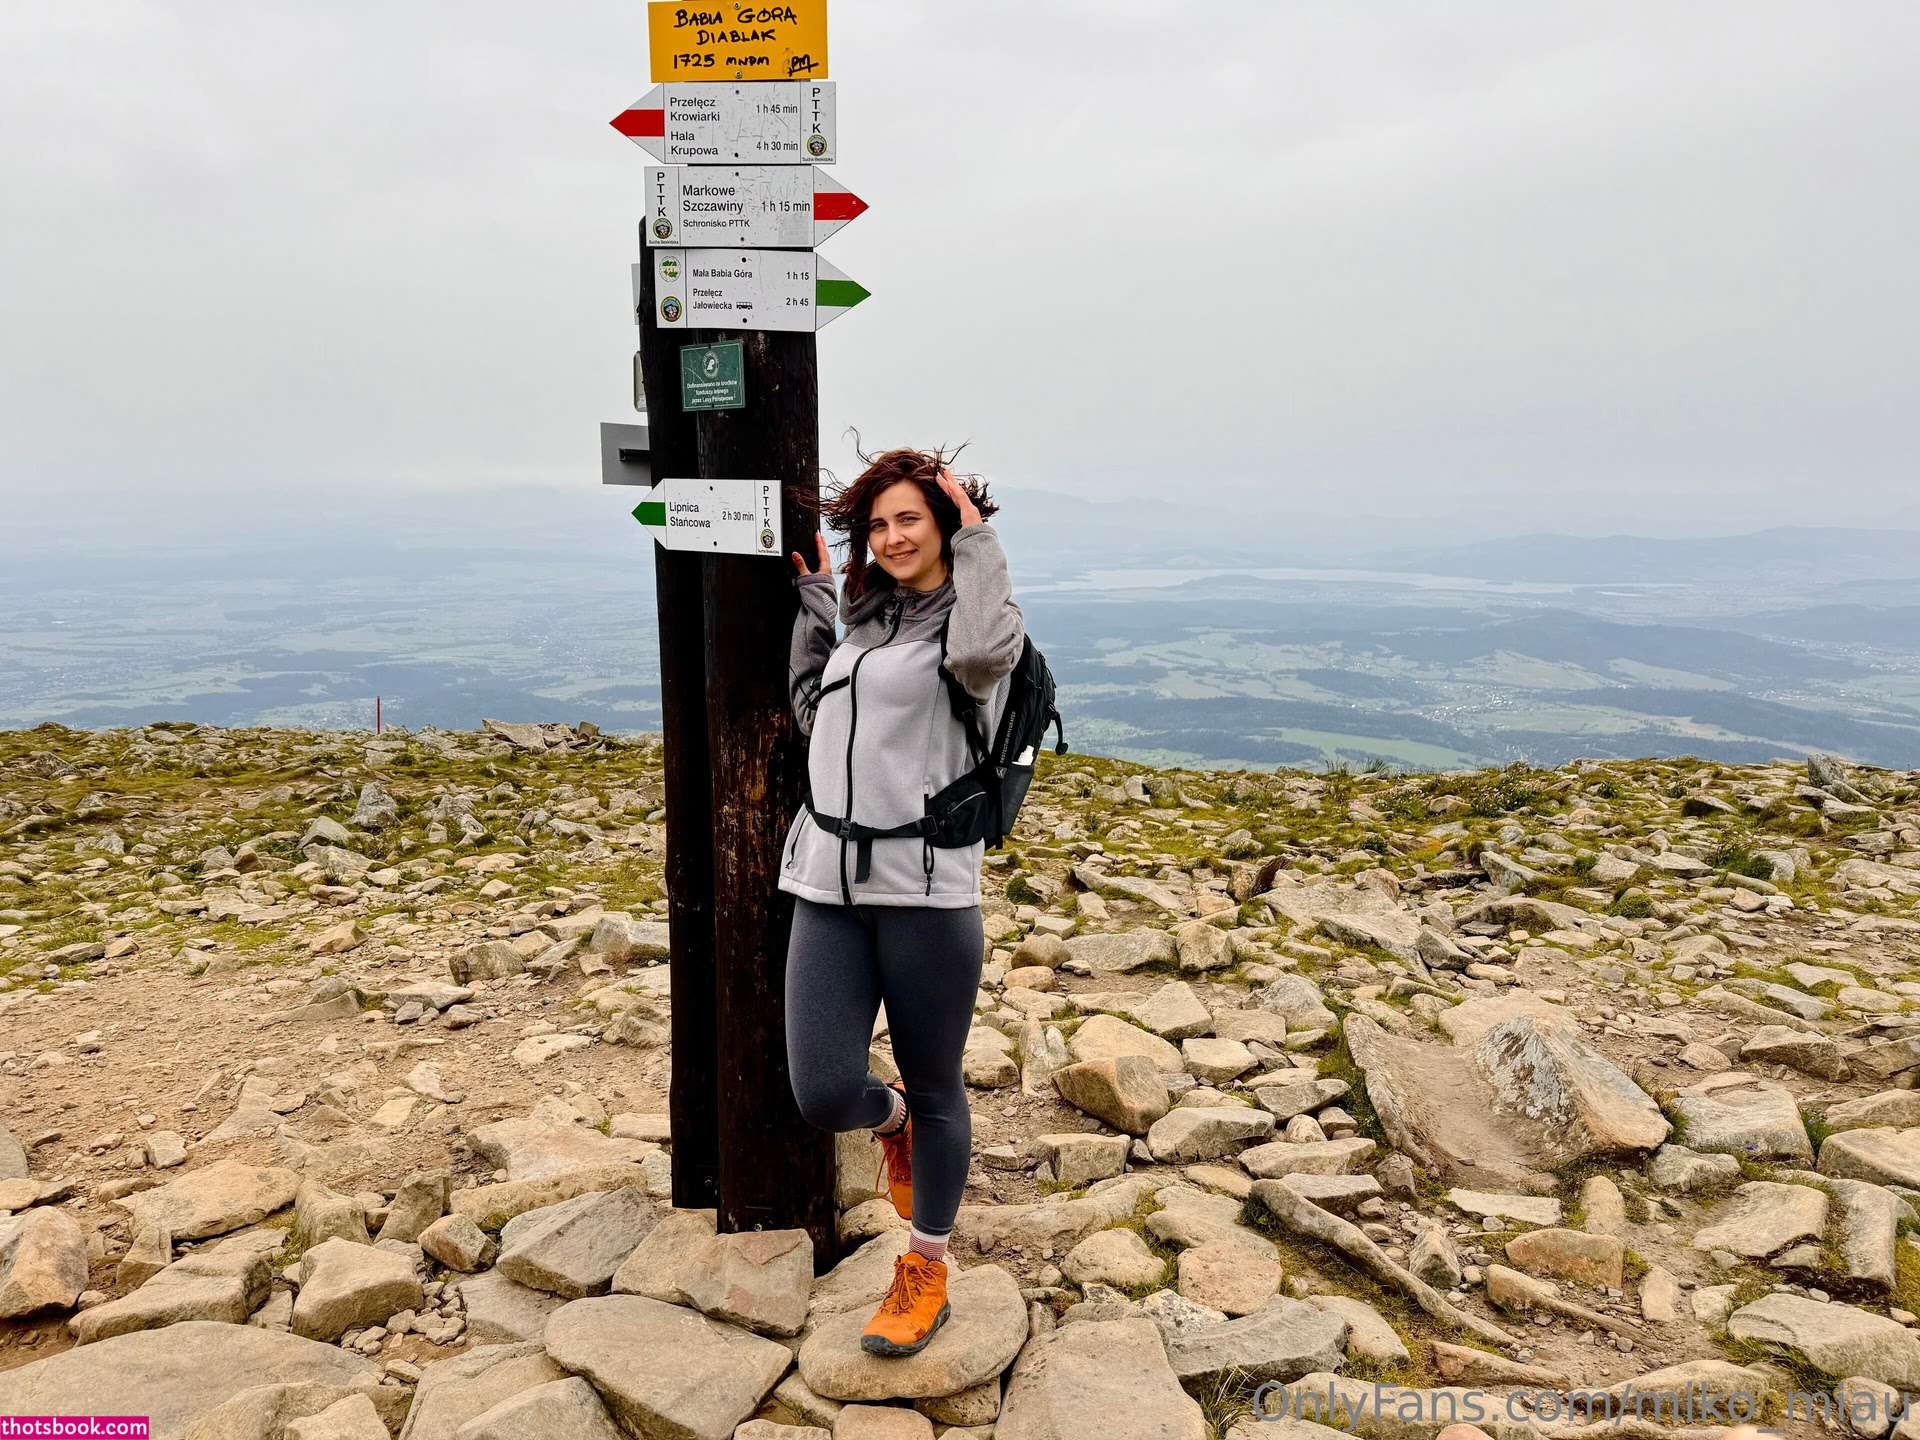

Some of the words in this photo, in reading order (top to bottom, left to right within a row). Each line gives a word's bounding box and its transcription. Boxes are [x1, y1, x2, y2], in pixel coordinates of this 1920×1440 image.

[673, 9, 723, 28] BABIA
[696, 29, 776, 45] DIABLAK
[673, 54, 715, 69] 1725
[756, 104, 760, 113] 1
[763, 104, 768, 113] h
[771, 104, 781, 113] 45
[783, 104, 798, 113] min
[812, 87, 821, 134] PTTK
[670, 111, 720, 121] Krowiarki
[670, 131, 695, 141] Hala
[671, 145, 719, 157] Krupowa
[756, 141, 761, 150] 4
[763, 141, 769, 150] h
[771, 141, 781, 150] 30
[783, 141, 798, 150] min
[656, 172, 666, 217] PTTK
[682, 185, 735, 196] Markowe
[682, 200, 744, 215] Szczawiny
[761, 201, 766, 212] 1
[769, 200, 776, 211] h
[778, 200, 790, 211] 15
[793, 200, 811, 211] min
[683, 219, 727, 228] Schronisko
[728, 219, 750, 228] PTTK
[692, 269, 709, 277] Mała
[711, 269, 732, 277] Babia
[734, 269, 753, 278] Góra
[786, 272, 790, 280] 1
[792, 272, 798, 280] h
[800, 272, 809, 280] 15
[692, 301, 732, 310] Jałowiecka
[786, 297, 790, 305] 2
[792, 298, 798, 306] h
[800, 298, 809, 306] 45
[669, 501, 699, 514] Lipnica
[722, 511, 727, 520] 2
[728, 511, 732, 520] h
[734, 511, 741, 520] 30
[742, 511, 754, 521] min
[670, 516, 711, 528] Stańcowa
